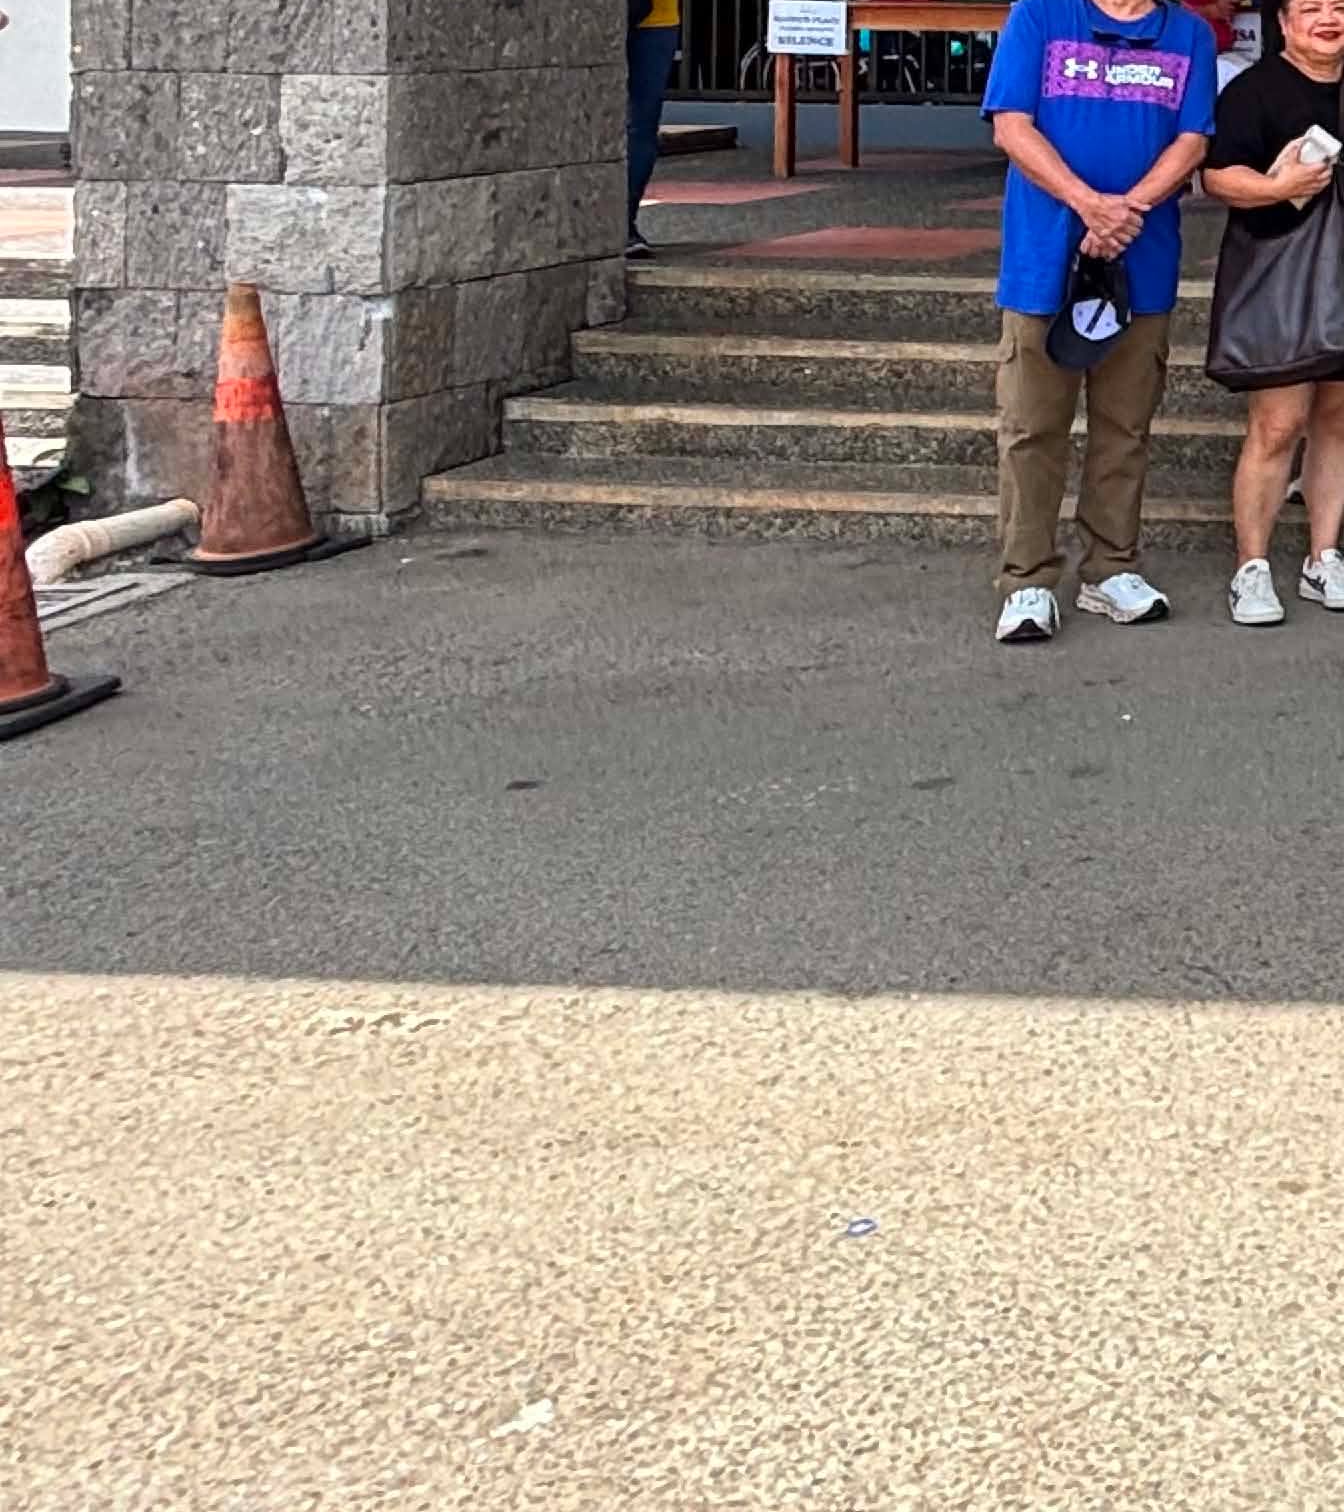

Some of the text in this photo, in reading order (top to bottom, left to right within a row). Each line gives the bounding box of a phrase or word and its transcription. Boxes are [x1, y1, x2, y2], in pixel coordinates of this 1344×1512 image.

[777, 36, 834, 47] SILENCE
[1105, 63, 1162, 76] UNDER
[1104, 72, 1174, 90] ARMOUR
